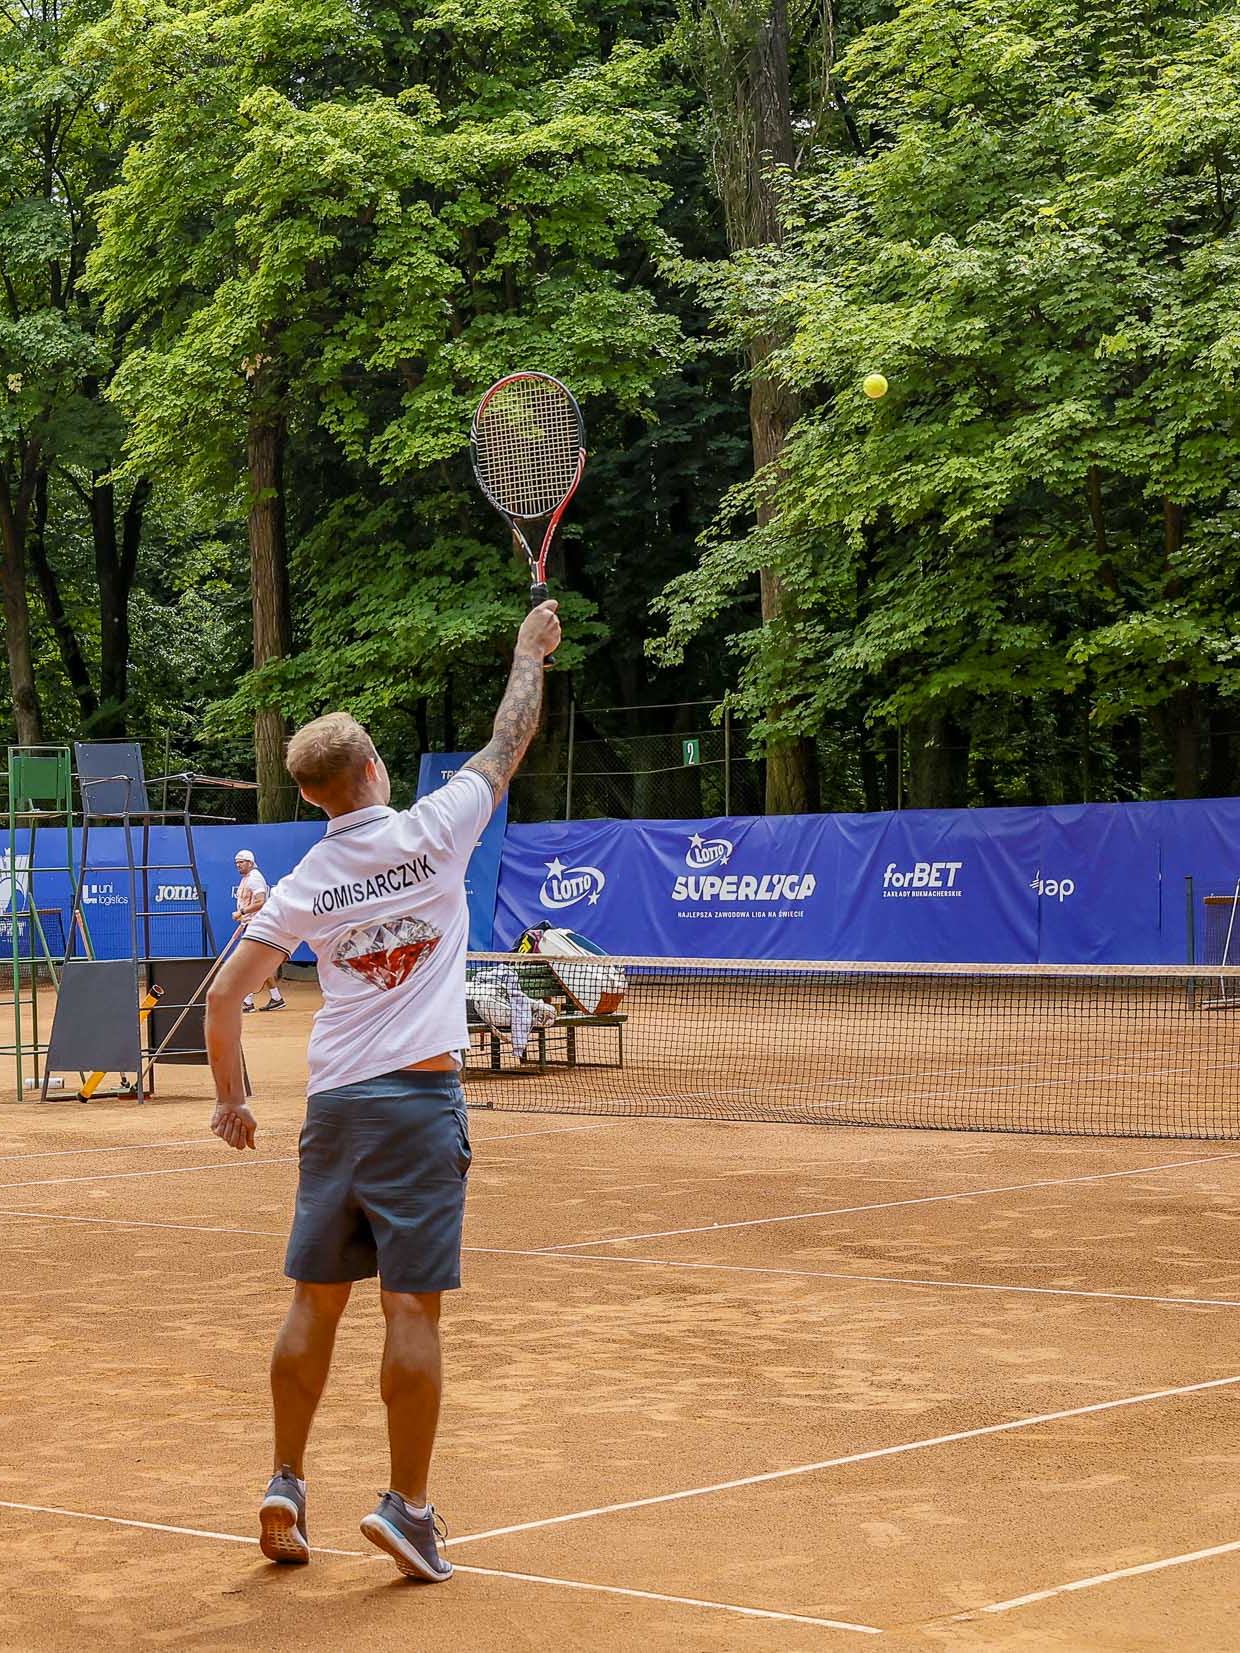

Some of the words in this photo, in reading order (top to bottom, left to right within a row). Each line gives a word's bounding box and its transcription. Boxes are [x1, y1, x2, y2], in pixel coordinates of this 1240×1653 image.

[687, 743, 694, 765] 2
[695, 845, 724, 862] LOTTO
[312, 854, 436, 916] KOMISARCZYK
[883, 862, 963, 888] forBET
[99, 882, 113, 894] uni
[552, 875, 591, 900] LOTTO
[671, 873, 817, 901] SUPERLIGA
[98, 894, 129, 906] logistics
